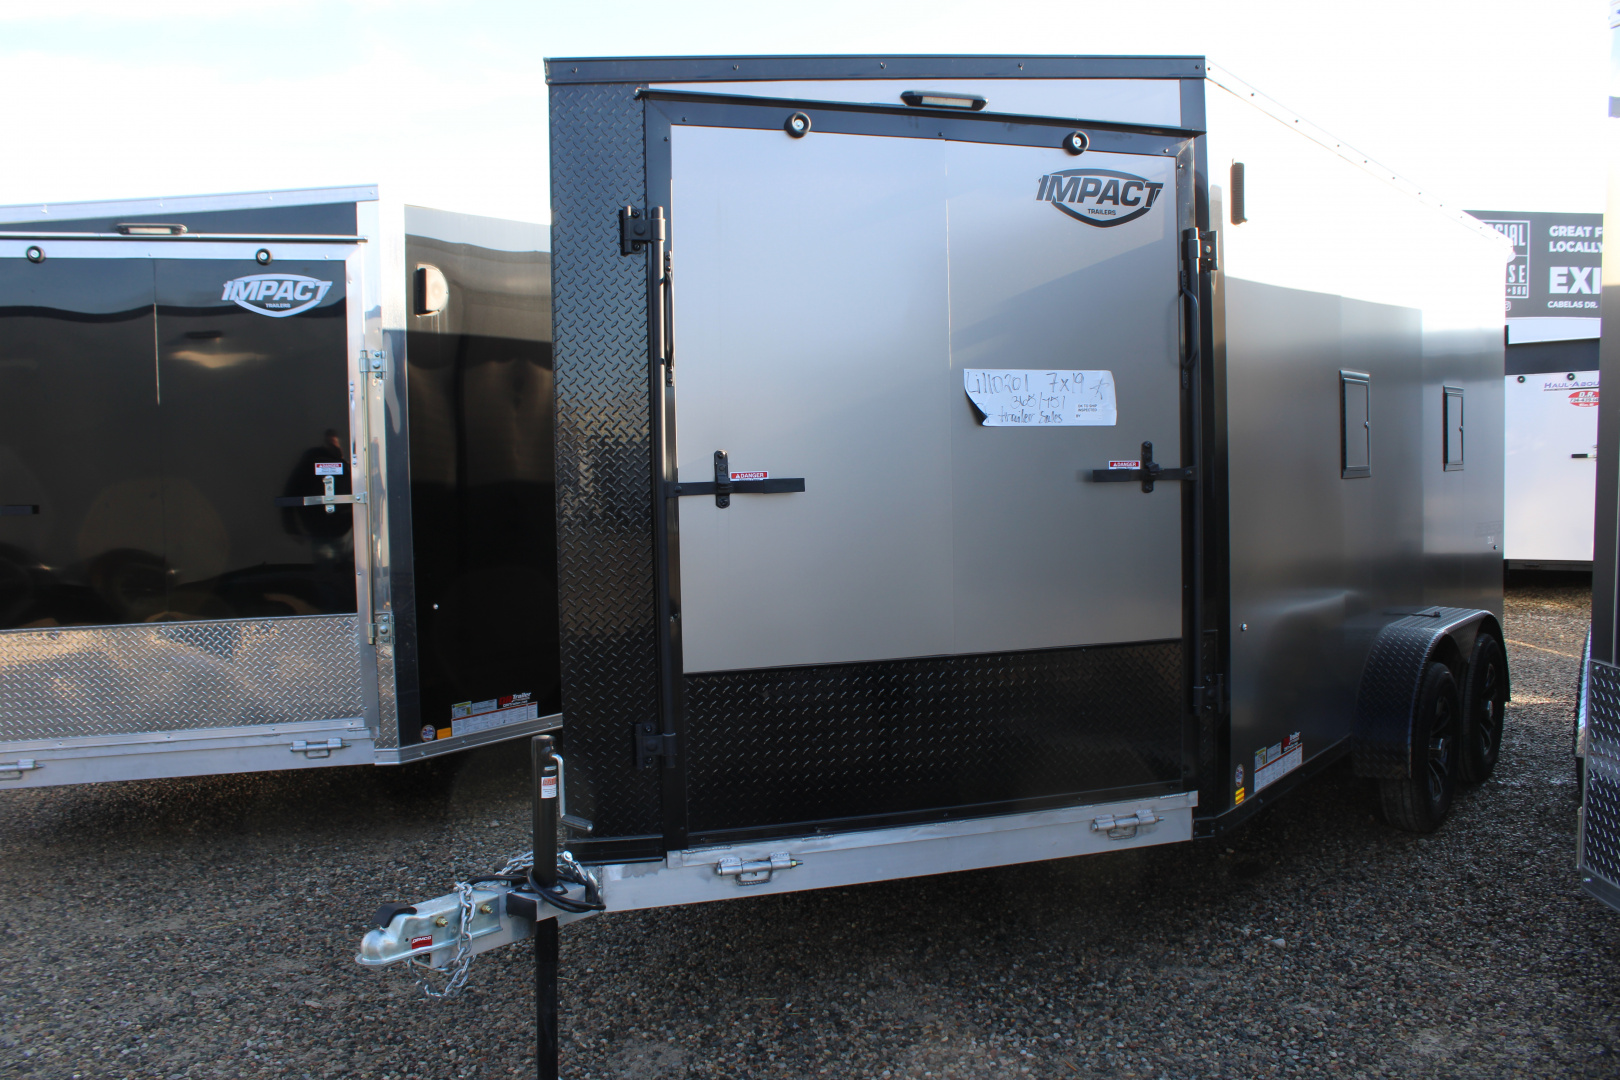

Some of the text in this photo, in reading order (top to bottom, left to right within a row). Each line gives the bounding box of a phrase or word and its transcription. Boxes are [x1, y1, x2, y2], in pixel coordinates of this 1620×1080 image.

[1036, 174, 1164, 208] IMPACT
[1549, 225, 1592, 237] GREAT
[221, 280, 333, 301] IMPACT
